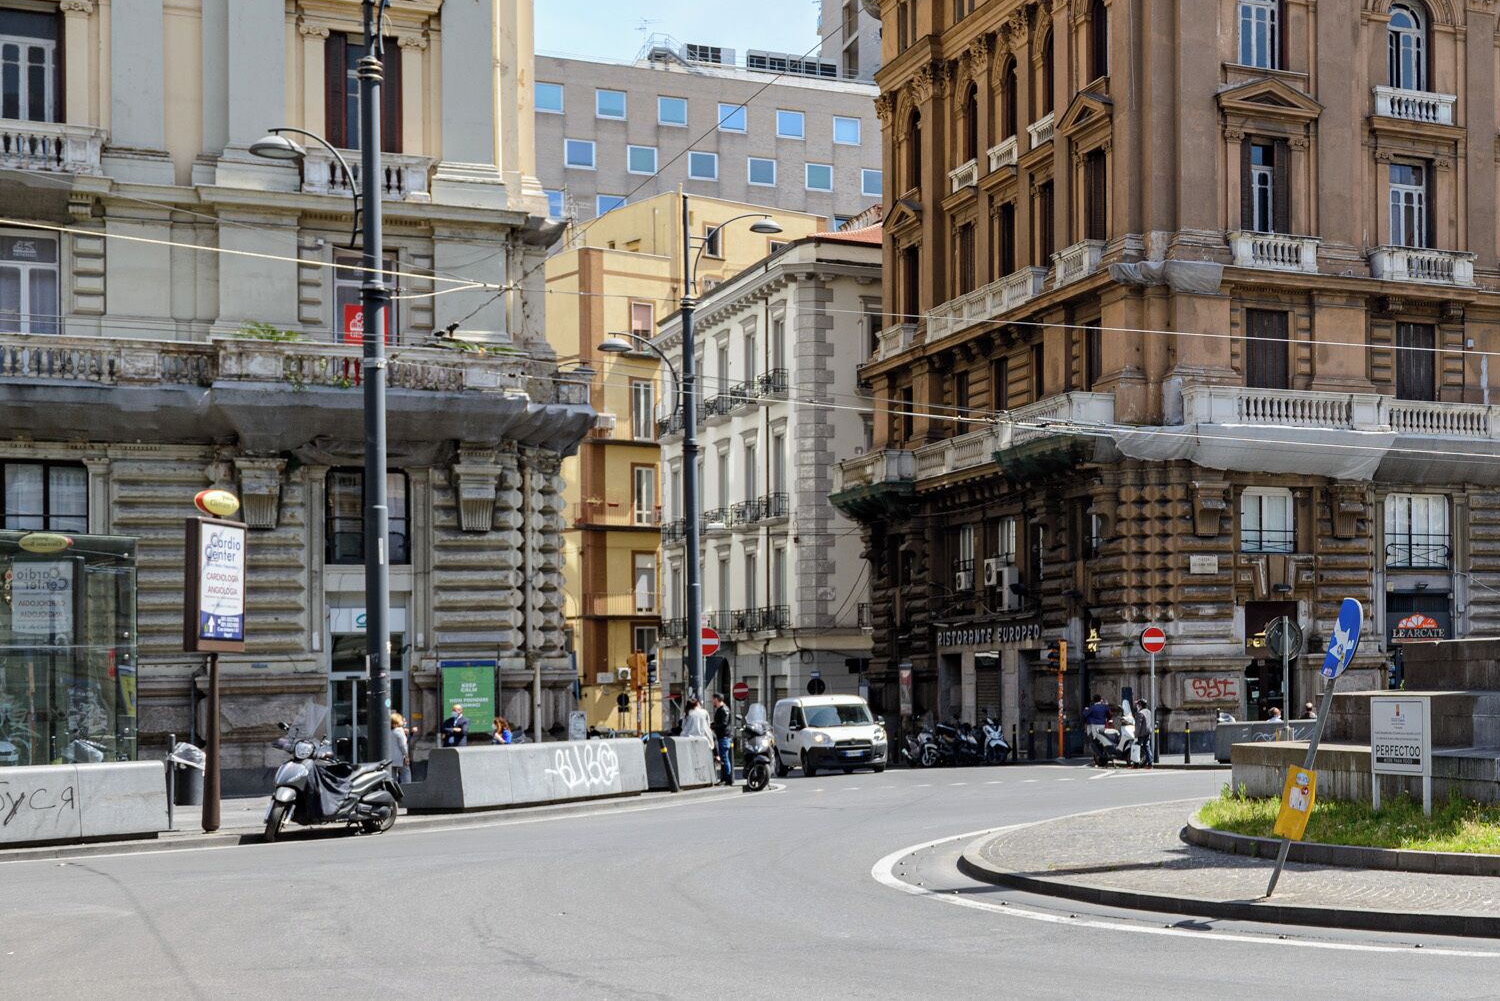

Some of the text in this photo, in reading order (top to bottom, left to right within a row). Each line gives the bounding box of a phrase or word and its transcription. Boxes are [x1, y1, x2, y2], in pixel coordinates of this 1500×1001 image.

[211, 532, 241, 551] Cardio
[205, 544, 236, 562] Center
[207, 572, 239, 583] CARDIOLOGIA
[937, 624, 1040, 647] RISTORANTE EUROPEO
[1392, 629, 1445, 638] LE ARCATE
[1375, 744, 1421, 757] PERFECTOO
